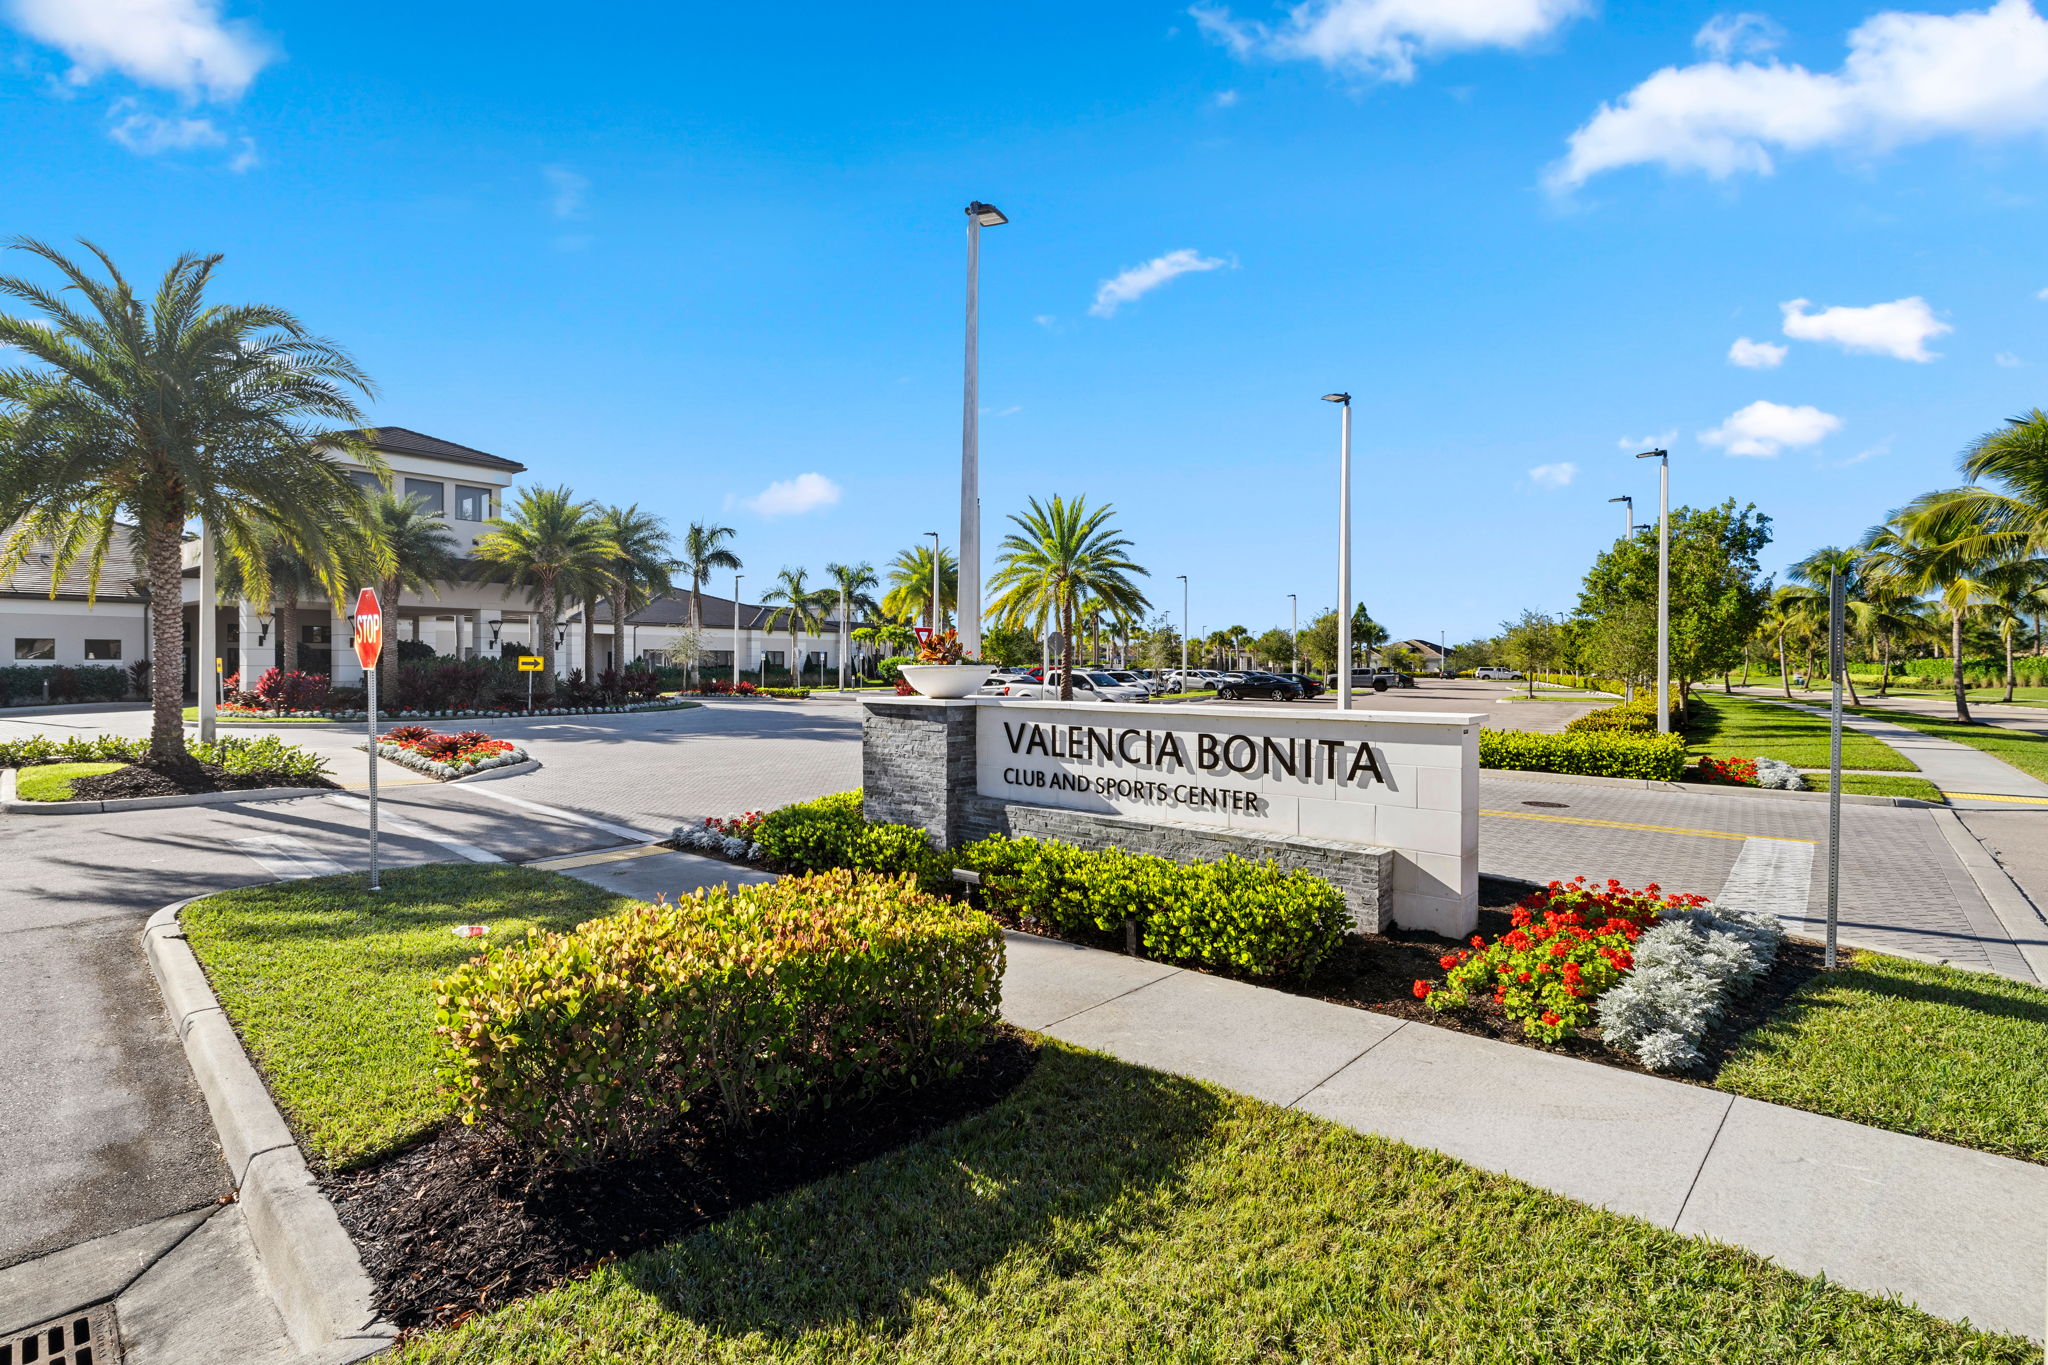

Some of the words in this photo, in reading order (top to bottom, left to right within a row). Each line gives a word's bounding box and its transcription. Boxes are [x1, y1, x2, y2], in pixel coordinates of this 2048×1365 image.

[357, 614, 379, 643] STOP
[1003, 722, 1184, 767] VALENCIA
[1198, 733, 1384, 783] BONITA
[1003, 768, 1046, 788] CLUB
[1049, 773, 1090, 792] AND
[1095, 777, 1168, 801] SPORTS
[1173, 785, 1259, 812] CENTER
